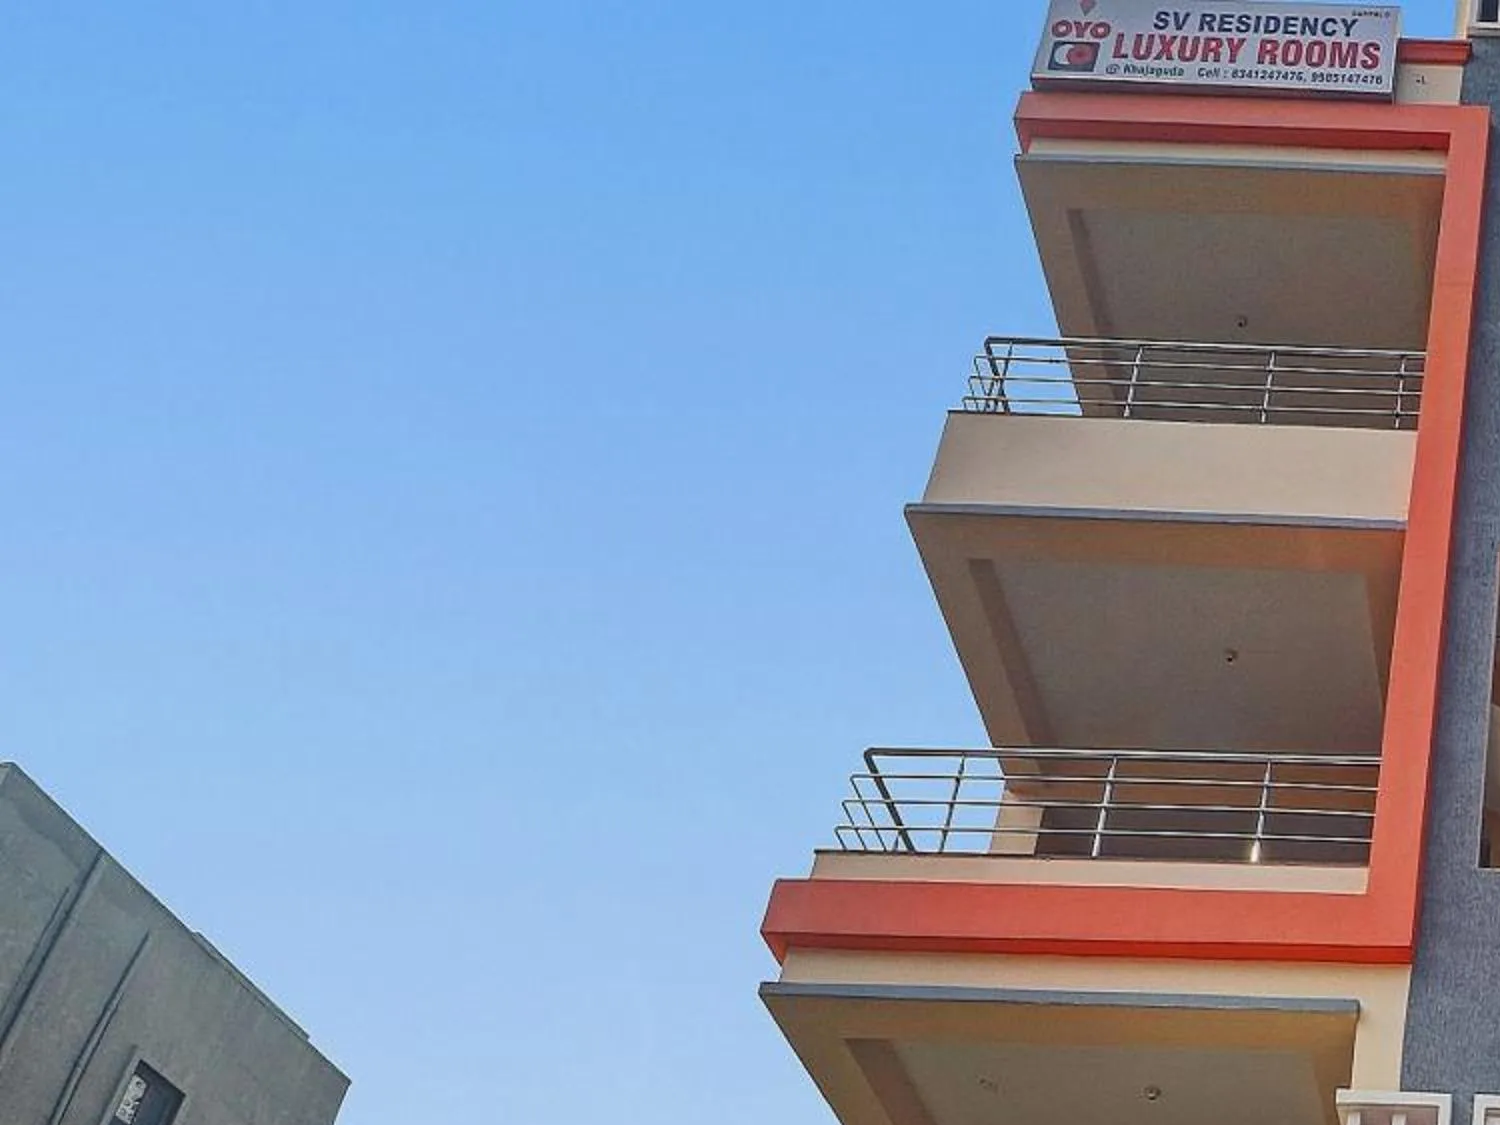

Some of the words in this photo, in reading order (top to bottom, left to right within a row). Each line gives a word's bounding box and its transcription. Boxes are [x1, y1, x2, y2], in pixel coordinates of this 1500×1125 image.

[1052, 20, 1111, 39] OYO
[1153, 11, 1191, 31] SV
[1199, 13, 1358, 37] RESIDENCY
[1112, 32, 1247, 64] LUXURY
[1257, 39, 1381, 70] ROOMS
